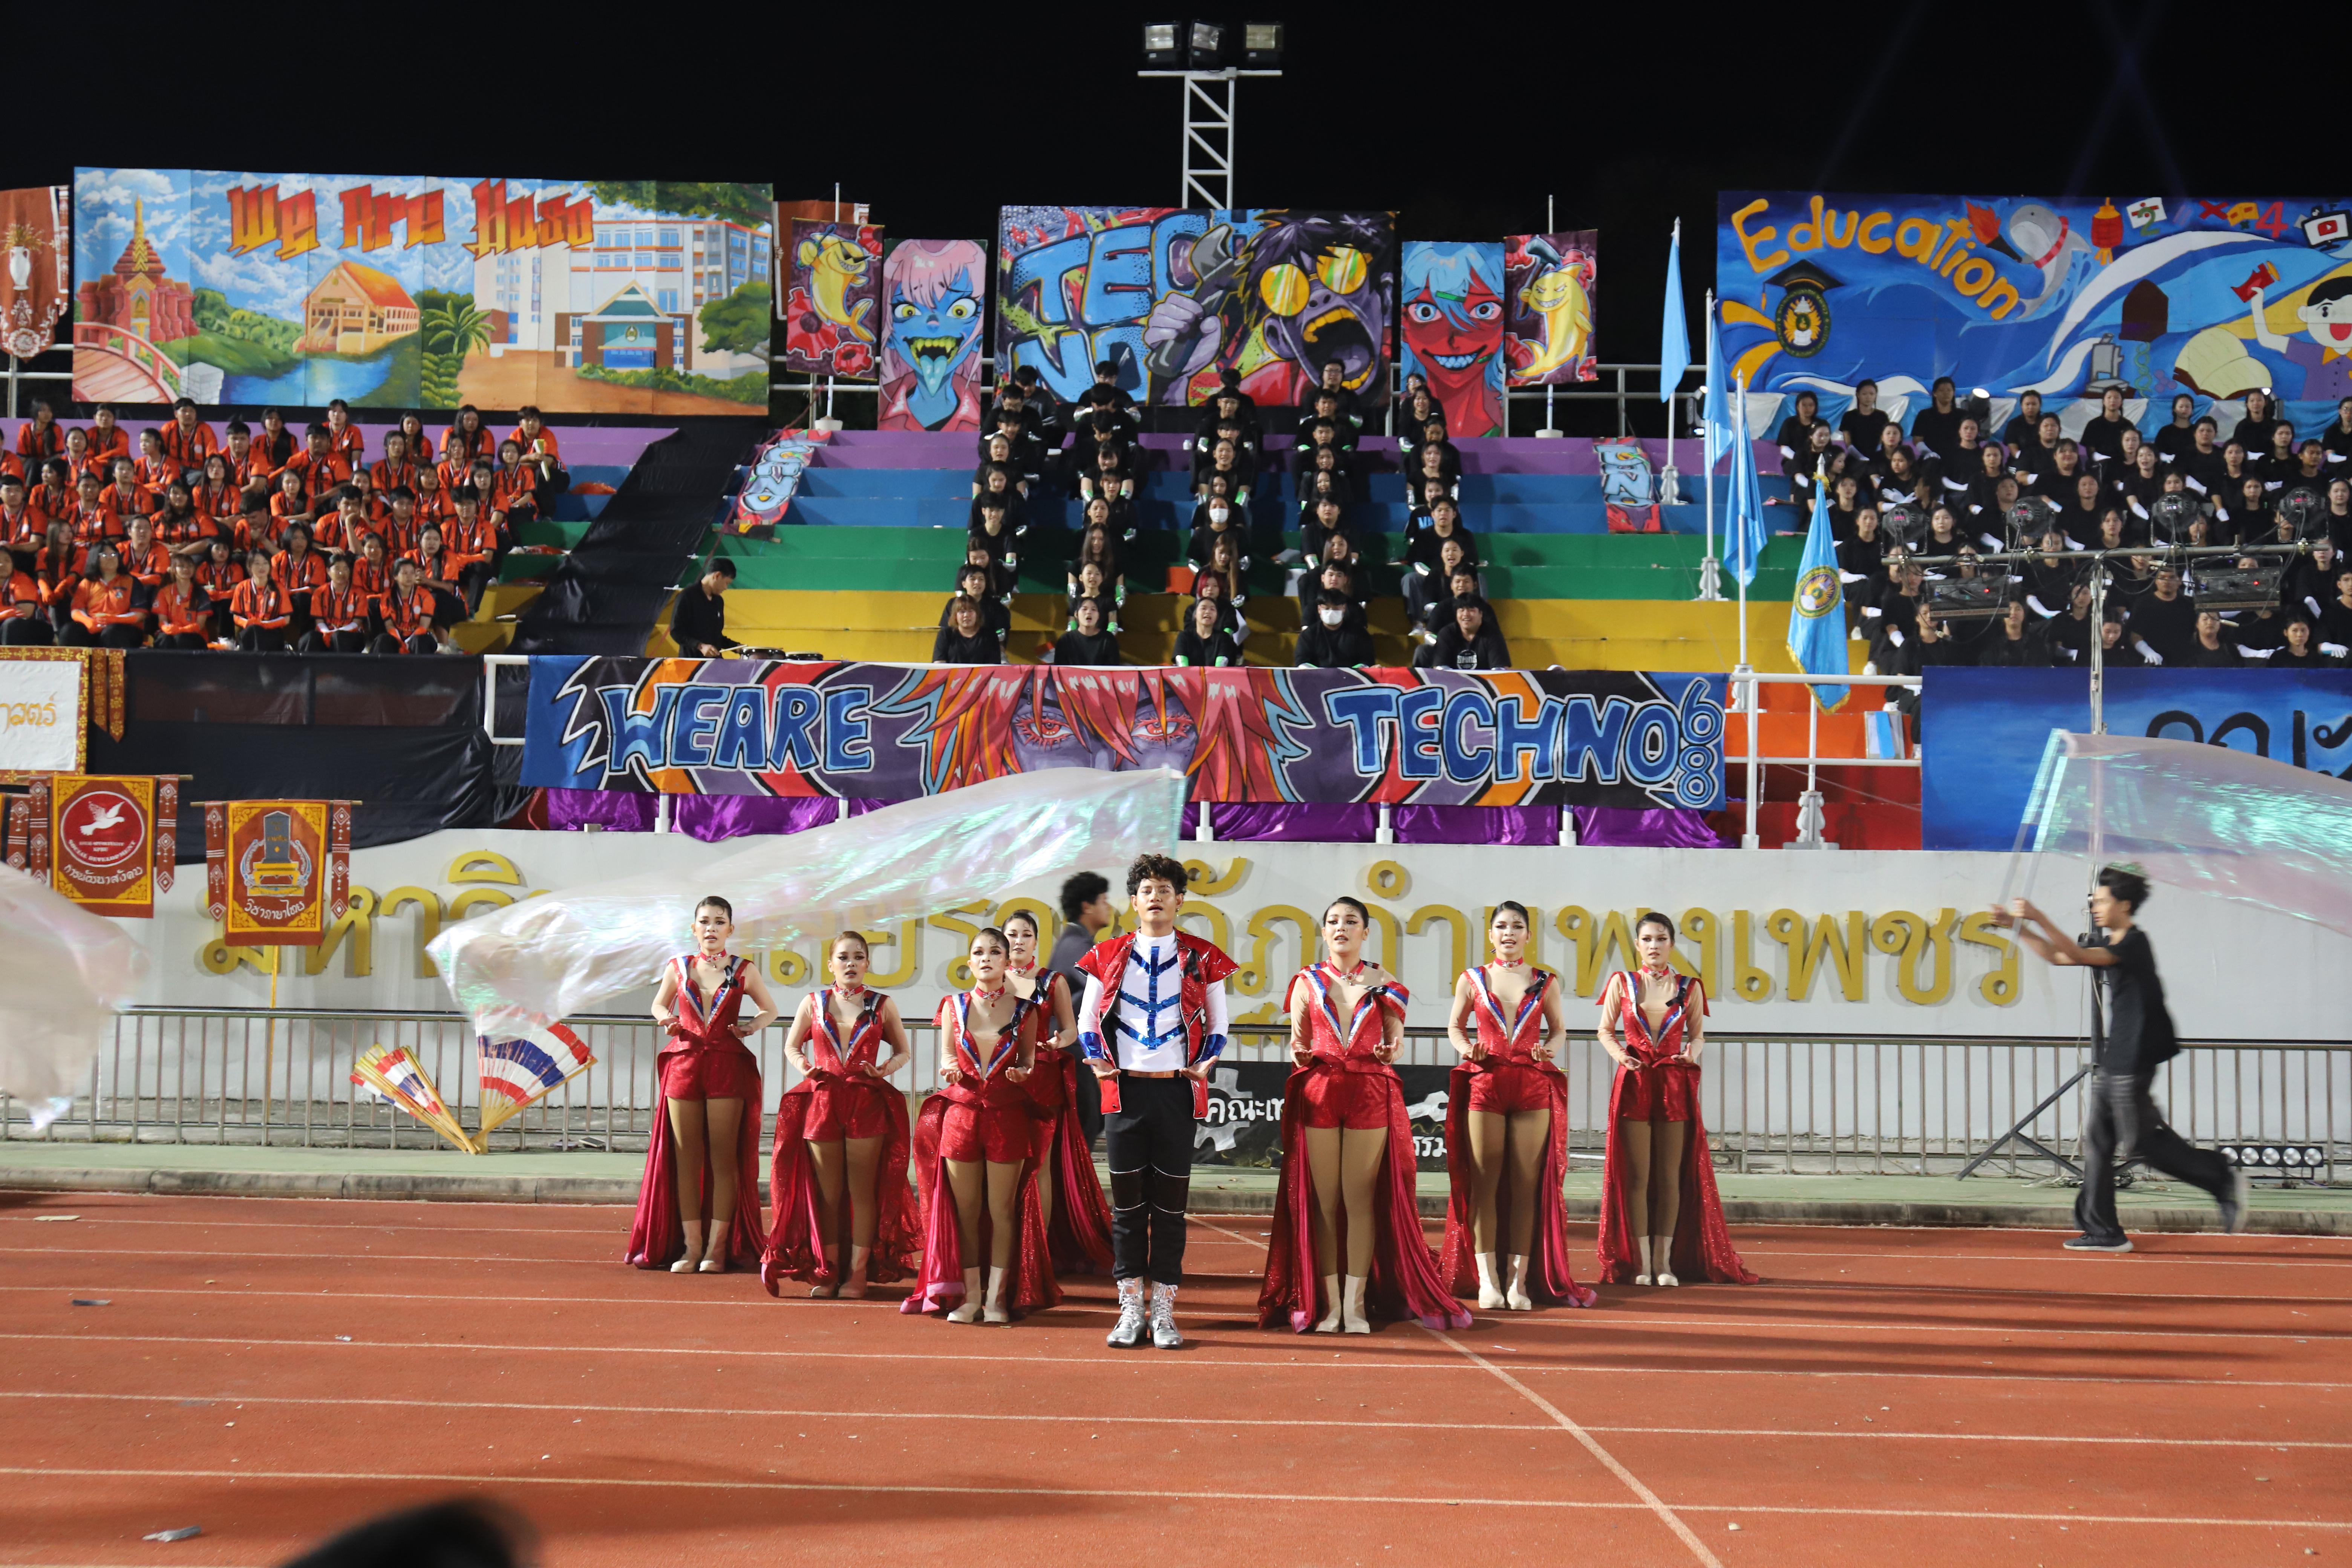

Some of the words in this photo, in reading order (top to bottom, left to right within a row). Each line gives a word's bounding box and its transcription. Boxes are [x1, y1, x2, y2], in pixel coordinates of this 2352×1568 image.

[1732, 195, 2019, 320] Education
[1322, 681, 1682, 787] TECHNO
[244, 898, 305, 920] วิชาภาษาไทย
